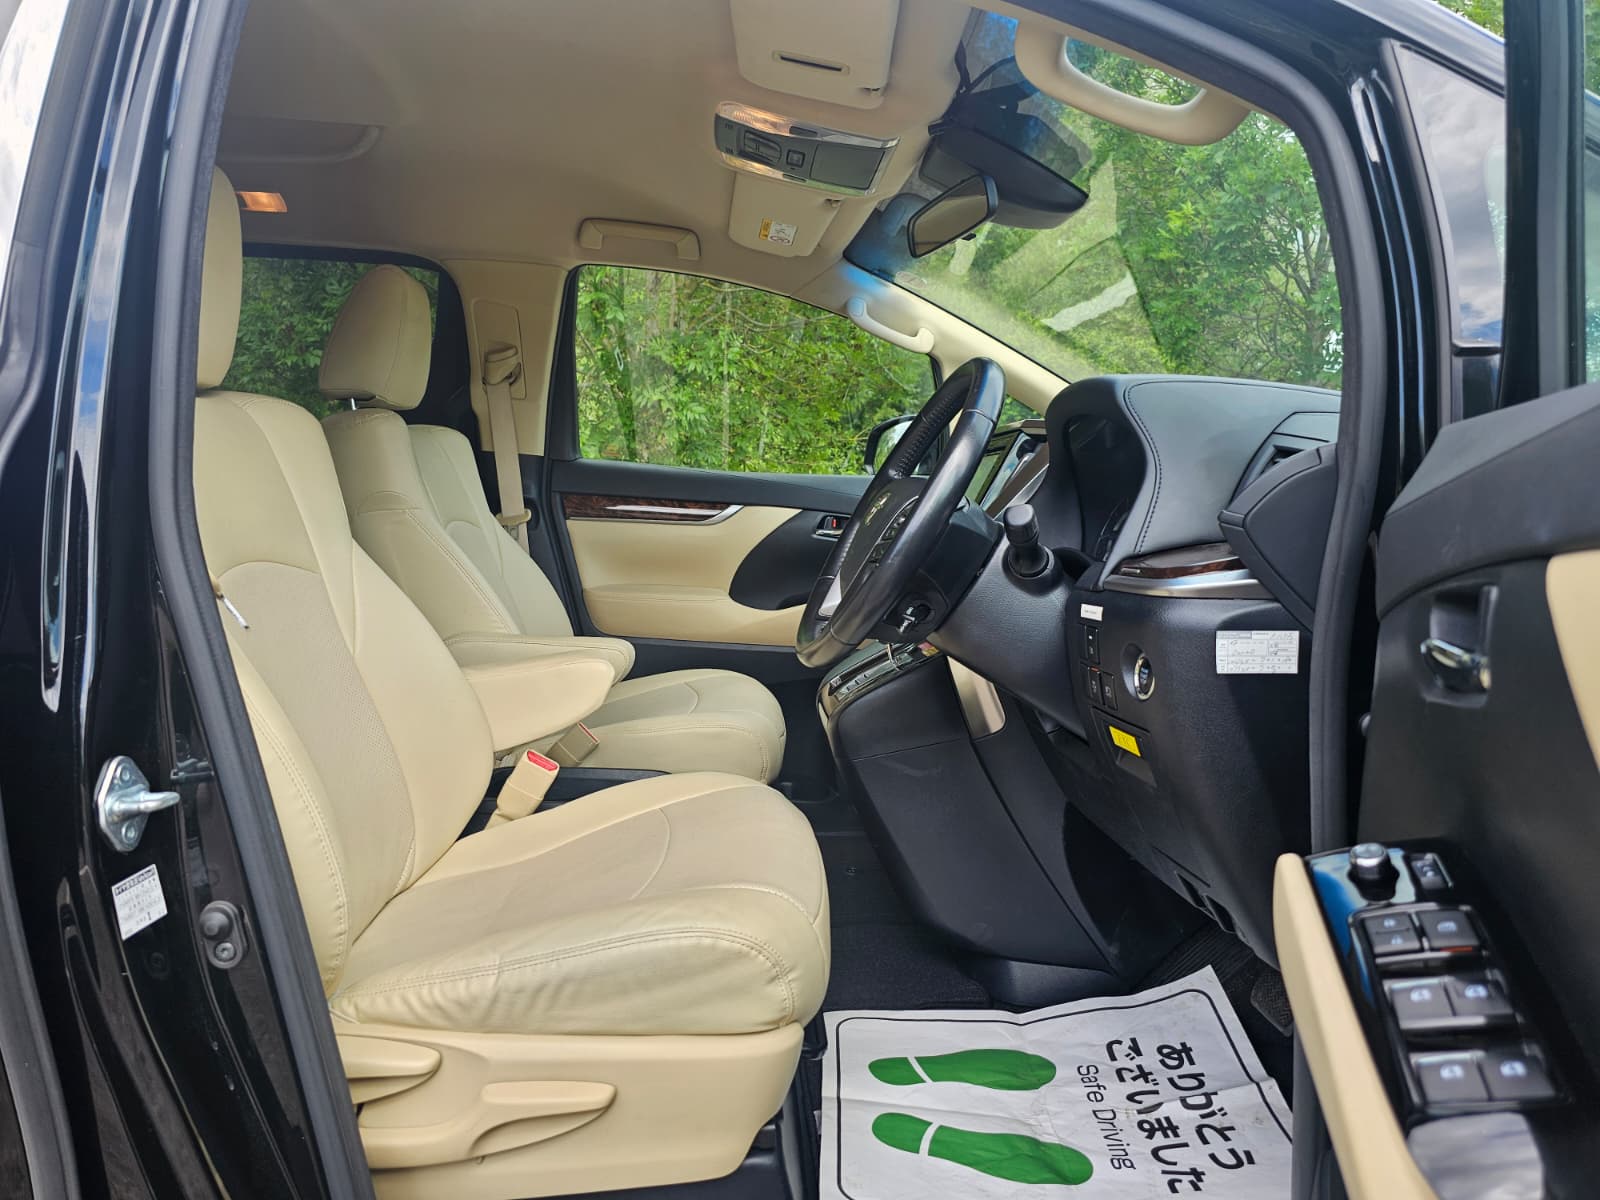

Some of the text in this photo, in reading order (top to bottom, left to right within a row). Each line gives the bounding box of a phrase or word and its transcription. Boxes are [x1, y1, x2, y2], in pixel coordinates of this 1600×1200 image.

[1077, 1064, 1137, 1170] Safe Driving
[1105, 1037, 1206, 1194] ございました
[1156, 1041, 1256, 1170] ありがとう
